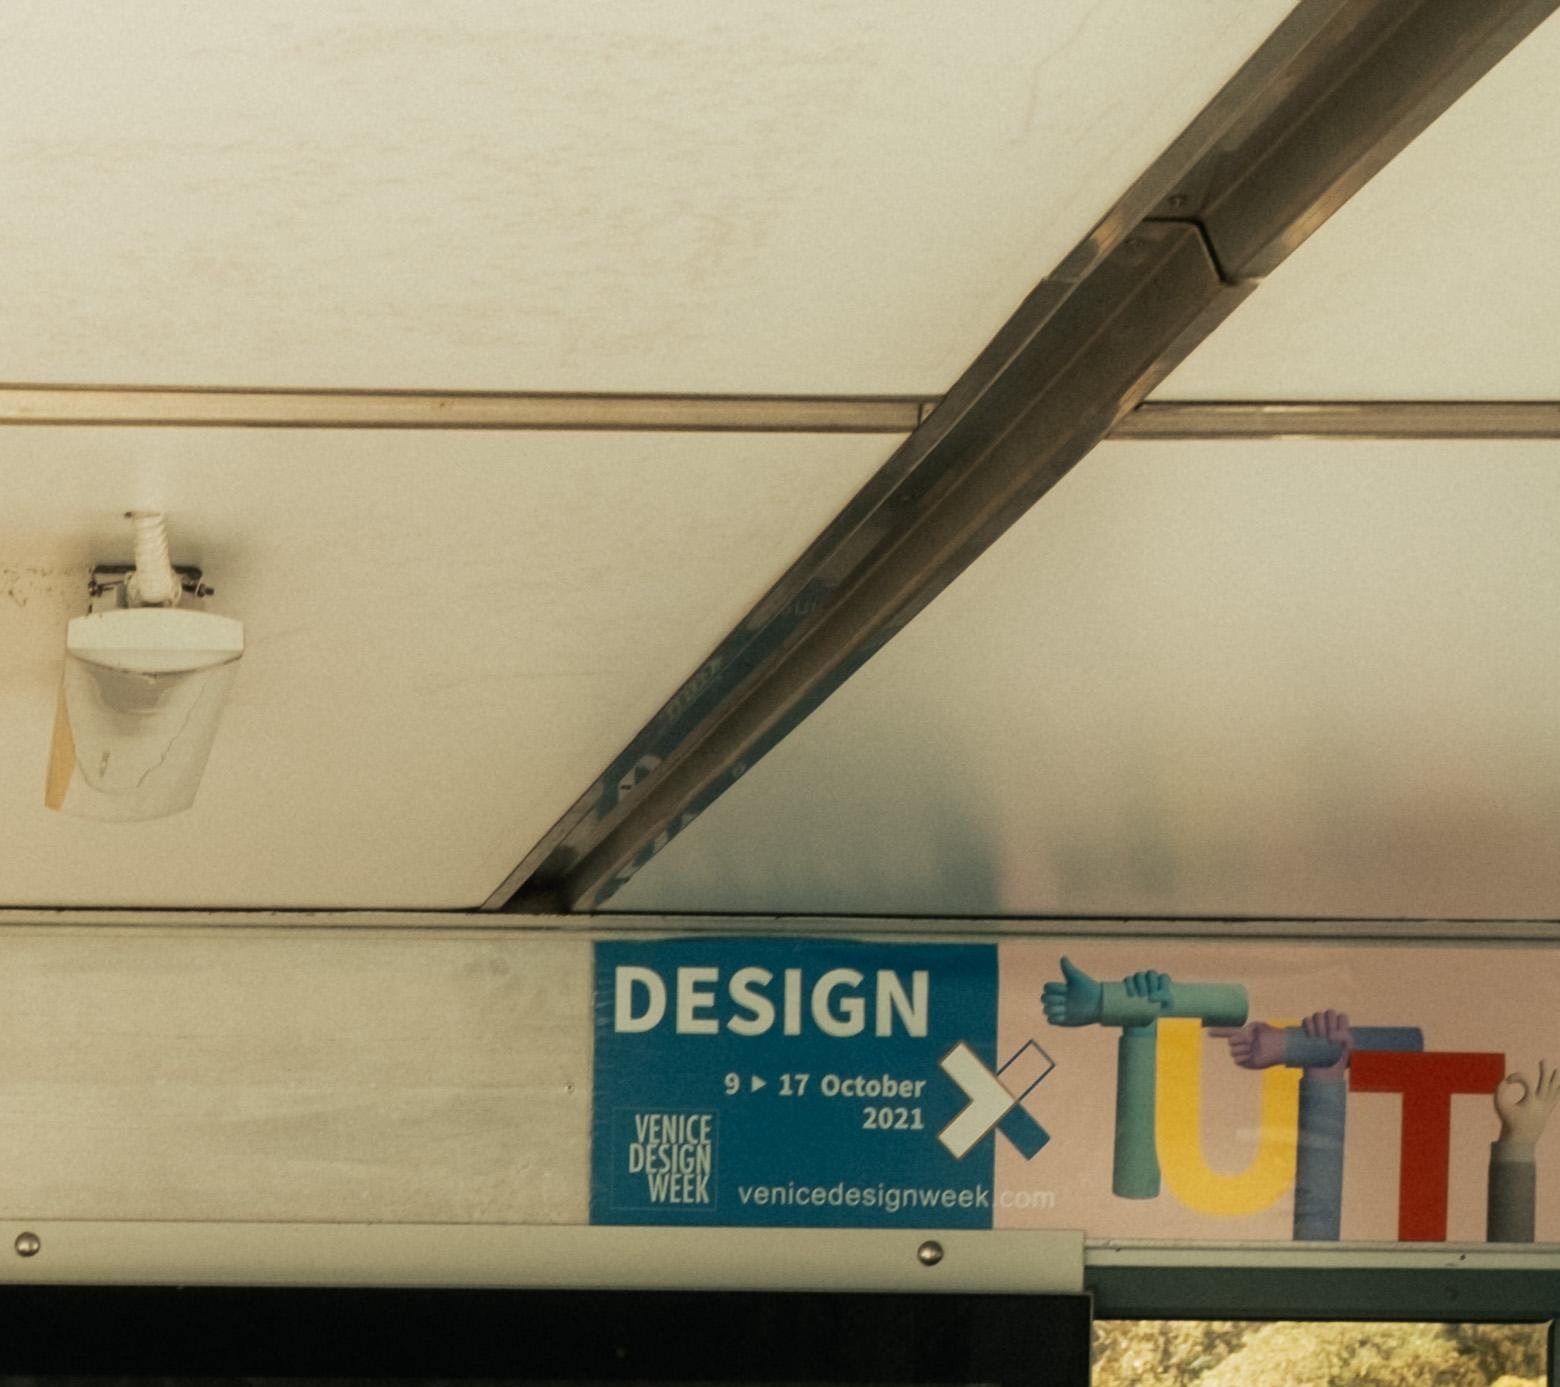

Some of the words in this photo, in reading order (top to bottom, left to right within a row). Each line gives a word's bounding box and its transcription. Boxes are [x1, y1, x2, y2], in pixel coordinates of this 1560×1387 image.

[614, 966, 930, 1037] DESIGN
[724, 1073, 741, 1096] 9
[779, 1073, 809, 1096] 17
[820, 1075, 926, 1099] October
[635, 1113, 712, 1144] VENICE
[862, 1106, 925, 1131] 2021
[628, 1143, 712, 1174] DESIGN
[648, 1173, 710, 1204] WEEK
[737, 1181, 1057, 1214] venicedesignweek.com
